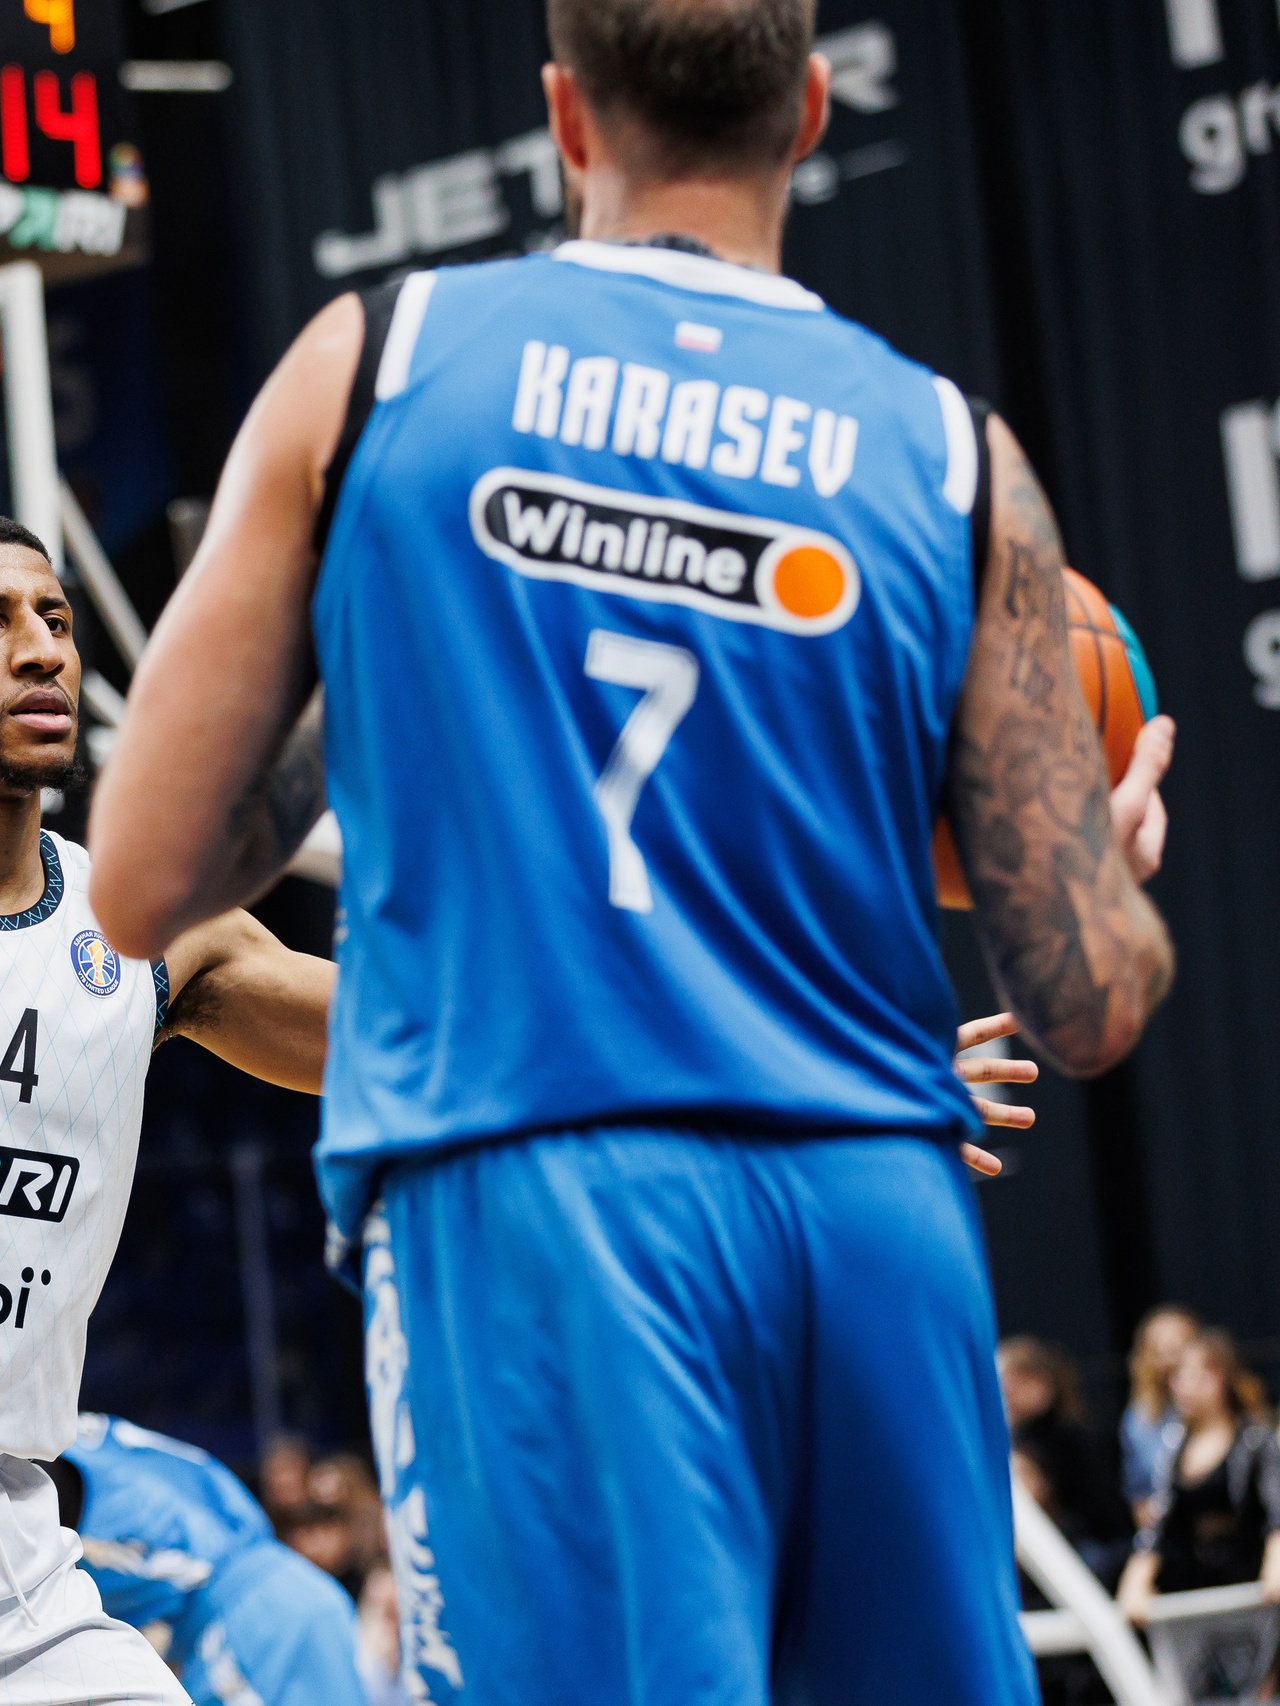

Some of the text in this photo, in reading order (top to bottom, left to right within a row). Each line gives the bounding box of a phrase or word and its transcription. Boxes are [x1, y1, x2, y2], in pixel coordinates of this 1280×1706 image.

[0, 62, 102, 189] 14
[512, 340, 860, 498] KARASEV
[502, 490, 748, 595] Winline
[584, 628, 700, 914] 7
